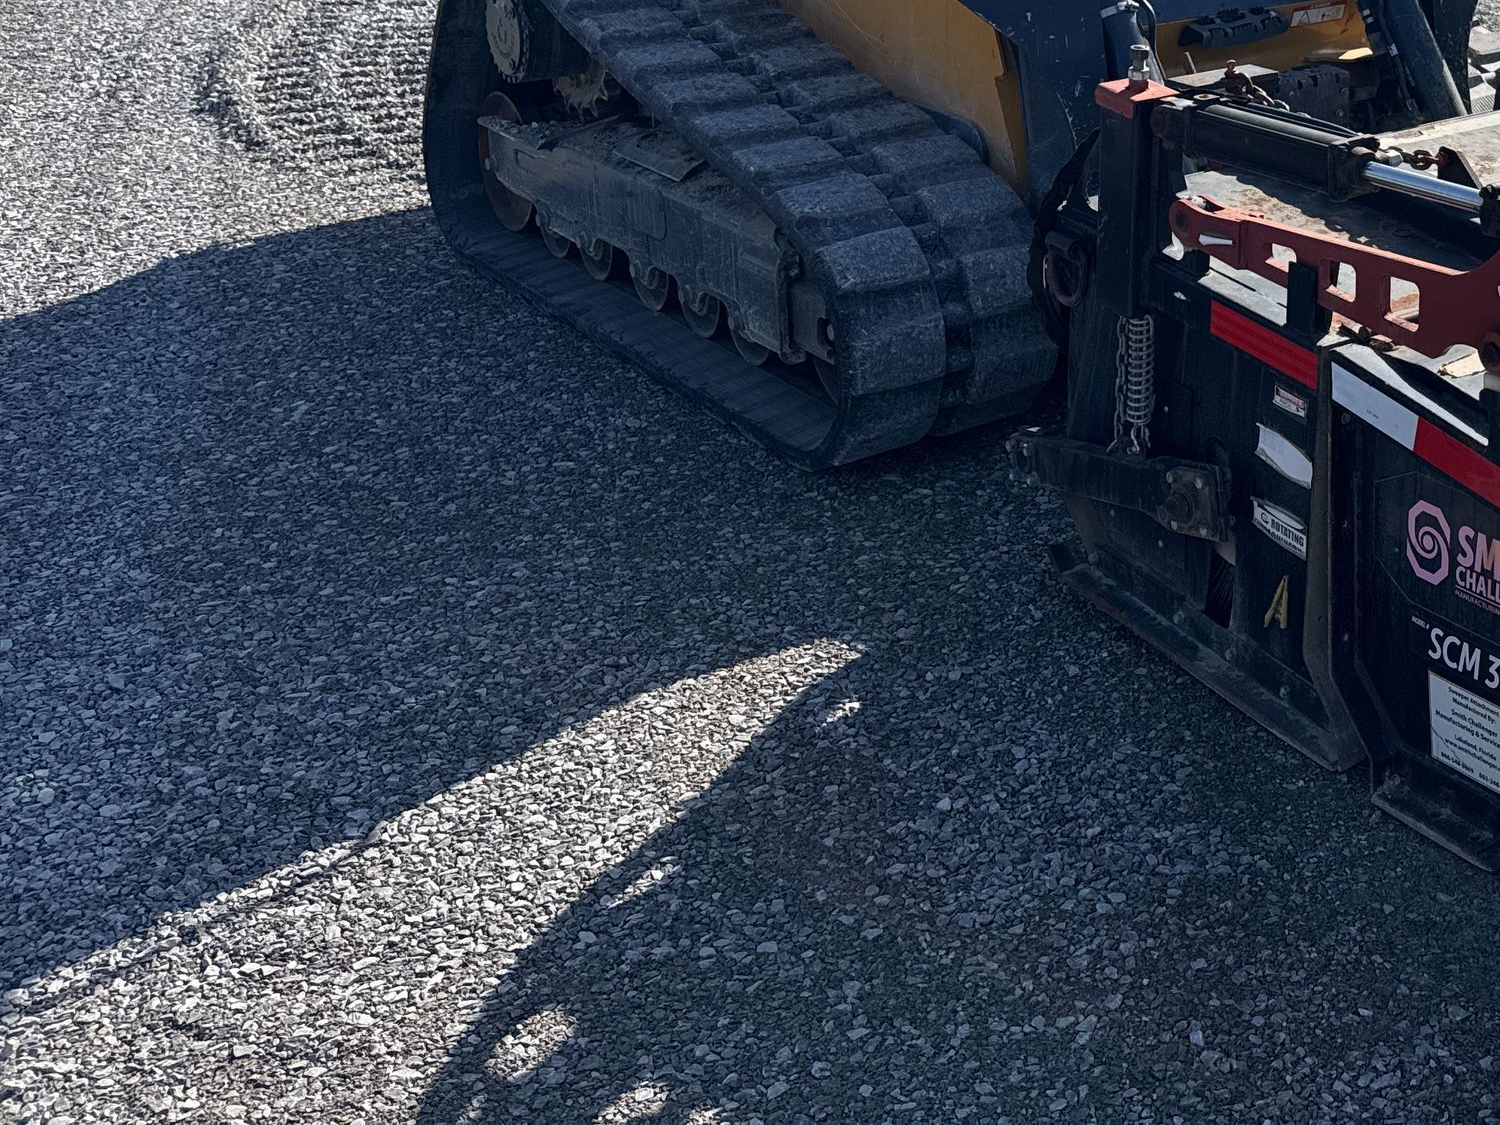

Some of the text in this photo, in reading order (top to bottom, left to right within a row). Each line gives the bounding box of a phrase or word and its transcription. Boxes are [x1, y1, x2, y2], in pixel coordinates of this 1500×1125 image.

[1270, 517, 1305, 547] ROTATING
[1263, 575, 1289, 629] A
[1428, 627, 1482, 681] SCM
[1448, 686, 1500, 717] Sweeper Attachment
[1452, 696, 1488, 720] Manufactured
[1435, 709, 1475, 737] Manufacturing
[1451, 708, 1498, 738] Smith Challenger
[1478, 746, 1497, 762] Florida
